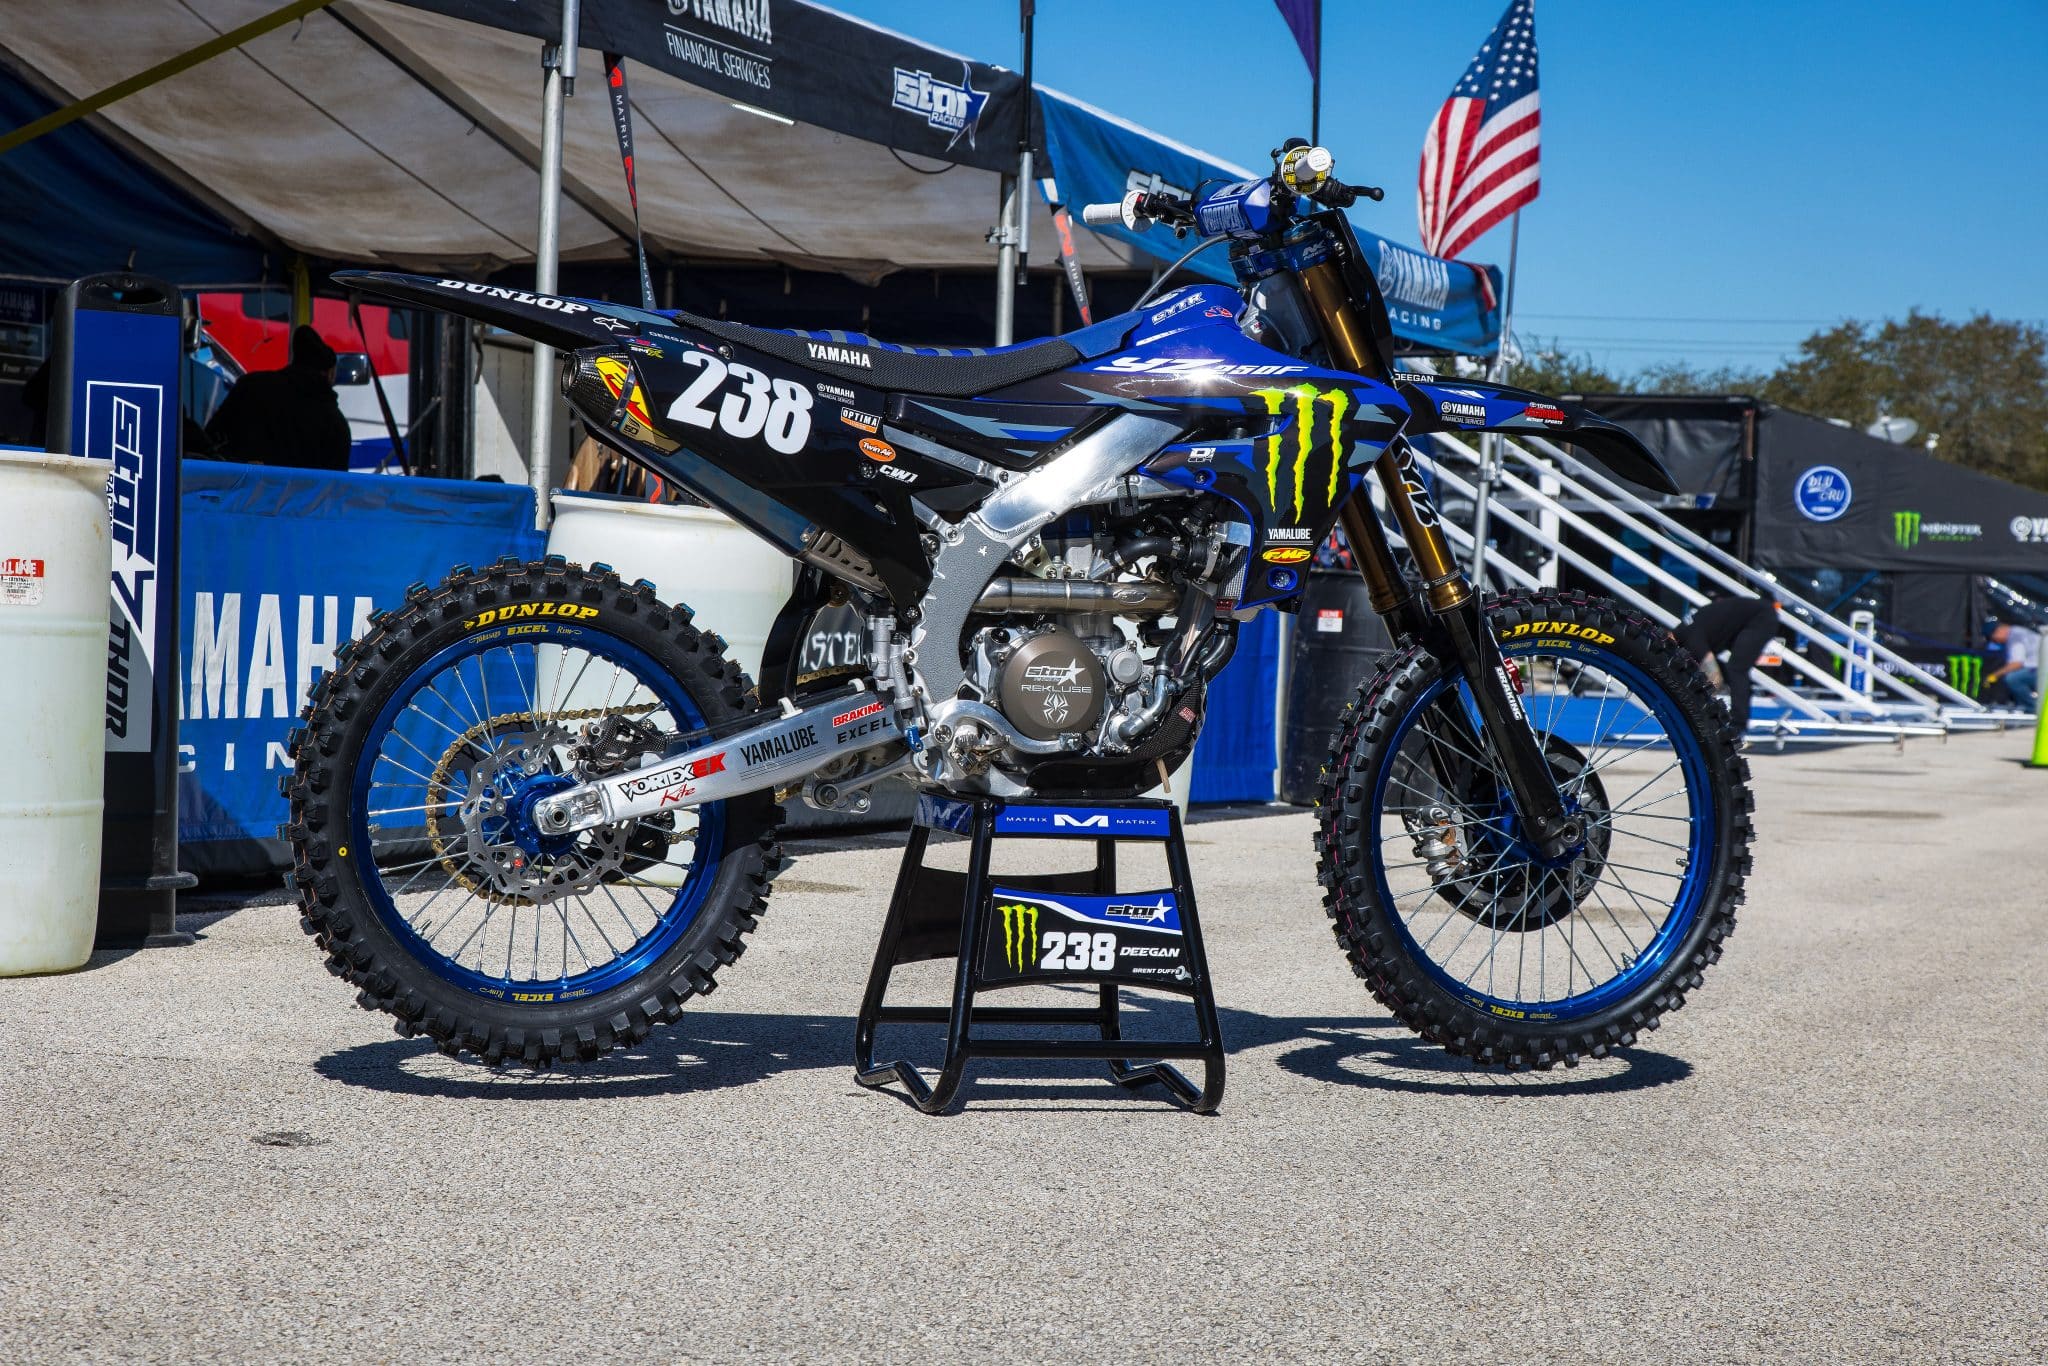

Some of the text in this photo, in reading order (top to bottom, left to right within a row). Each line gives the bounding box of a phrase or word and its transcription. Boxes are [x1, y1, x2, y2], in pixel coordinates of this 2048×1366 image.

[666, 32, 771, 89] FINANCIAL SERVICES
[616, 94, 629, 149] MATRIX
[931, 112, 965, 128] RACING
[437, 279, 590, 315] DUNLOP
[1388, 306, 1442, 331] ACING
[807, 342, 872, 369] YAMAHA
[825, 384, 855, 399] YAMAHA
[666, 350, 814, 455] 238
[1451, 403, 1486, 417] YAMAHA
[843, 409, 877, 427] OPTIMA
[863, 441, 881, 454] Twin
[1268, 528, 1311, 540] YAMALUBE
[476, 602, 599, 628] DUNLOP
[506, 624, 550, 636] EXCEL
[1511, 621, 1616, 645] DUNLOP
[1536, 639, 1573, 649] EXCEL
[1021, 684, 1092, 694] REKLUSE
[832, 702, 885, 728] BRAKING
[836, 716, 893, 745] EXCEL
[739, 724, 819, 767] YAMALUBE
[1040, 931, 1116, 971] 238
[1120, 946, 1180, 958] DEEGAN
[511, 991, 554, 1002] EXCEL
[1489, 1004, 1526, 1019] EXCEL
